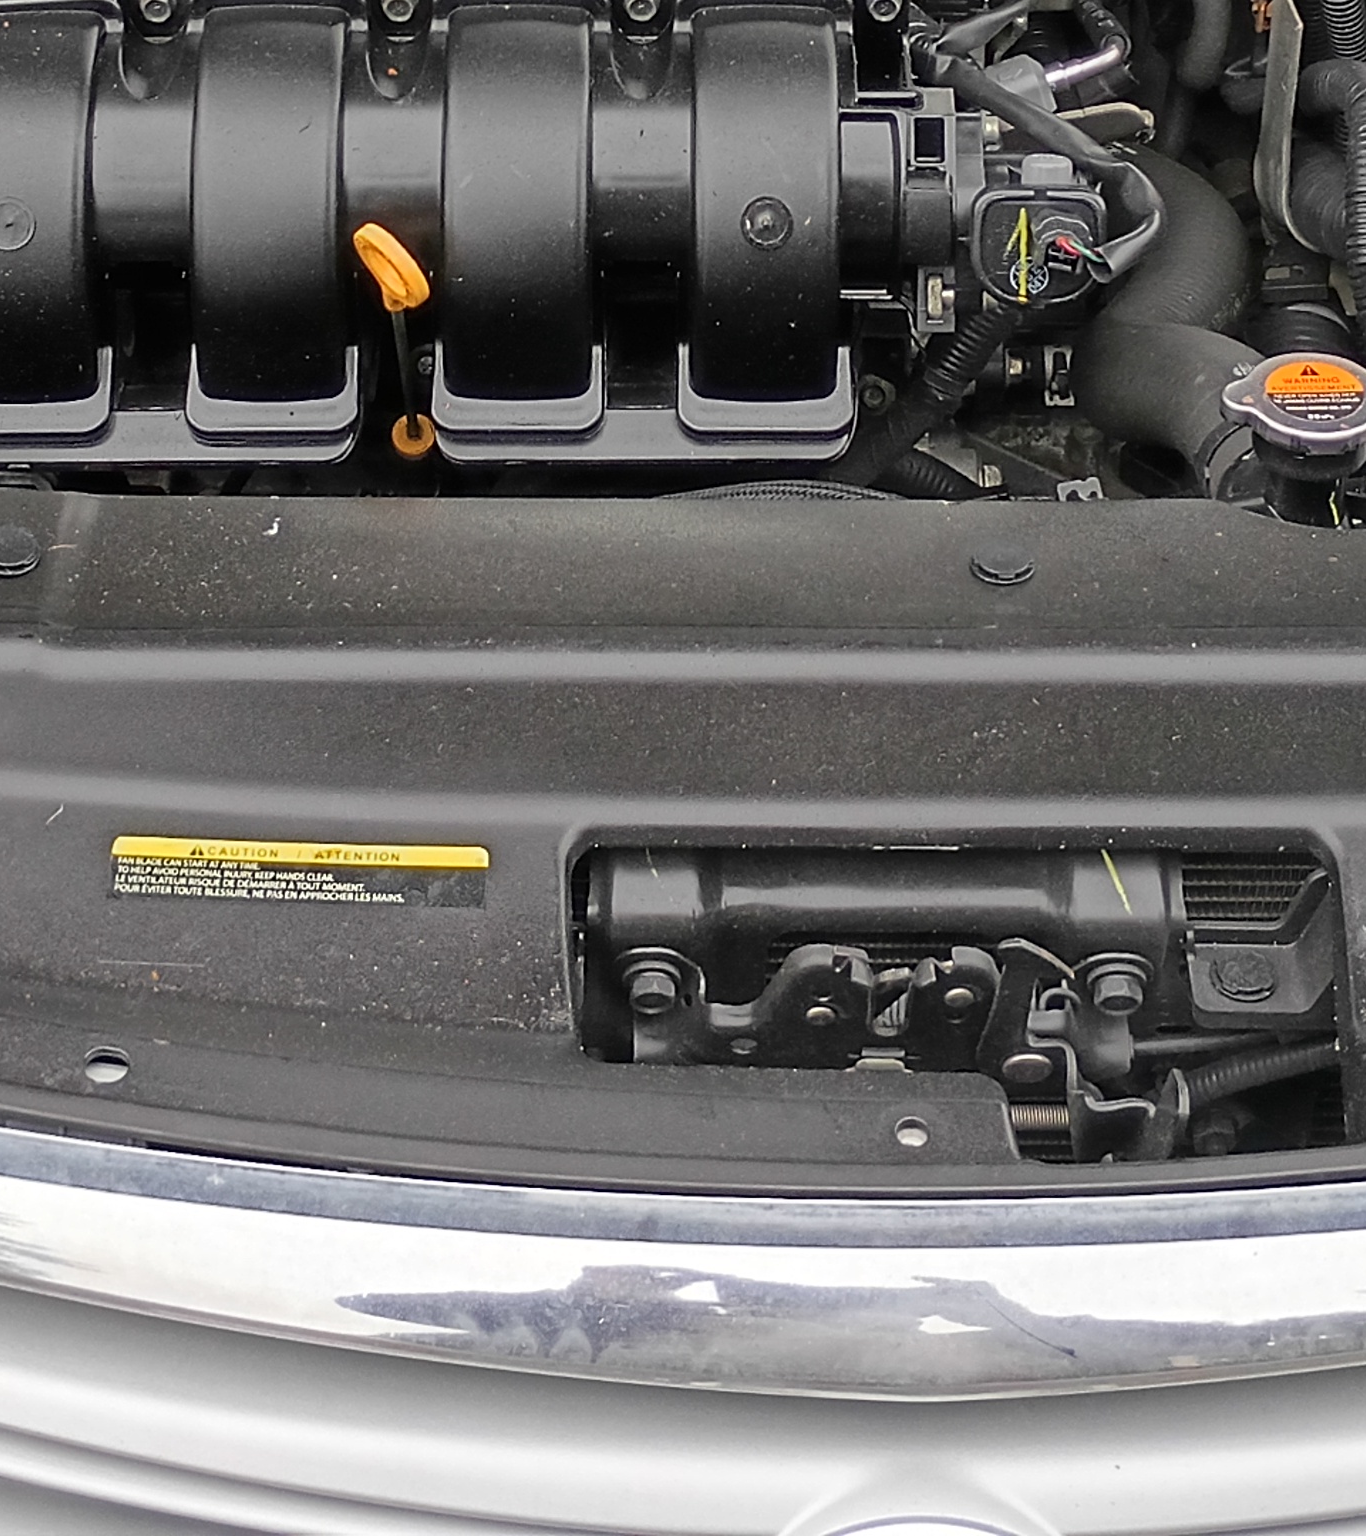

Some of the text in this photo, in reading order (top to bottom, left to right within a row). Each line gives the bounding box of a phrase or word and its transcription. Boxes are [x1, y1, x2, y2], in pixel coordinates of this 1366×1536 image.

[1282, 376, 1340, 384] WARNING
[117, 856, 135, 864] FAN
[136, 857, 162, 866] BLADE
[163, 858, 182, 867] CAN
[183, 859, 208, 868] START
[207, 846, 279, 858] CAUTION
[314, 848, 401, 862] ATTENTION
[118, 865, 129, 873] TO
[130, 865, 152, 874] HELP
[152, 866, 179, 876] AVOID
[179, 867, 222, 877] PERSONAL
[276, 871, 305, 881] HANDS
[115, 874, 125, 882] LE
[127, 875, 187, 885] VENTILATEUR
[188, 877, 220, 887] RISQUE
[222, 878, 235, 887] DE
[296, 882, 322, 891] TOUT
[114, 884, 140, 893] POUR
[173, 885, 203, 895] TOUTE
[252, 889, 265, 899] NE
[266, 890, 283, 899] PAS
[284, 890, 297, 900] EN
[298, 891, 354, 901] APPROCHER
[355, 892, 371, 902] LES
